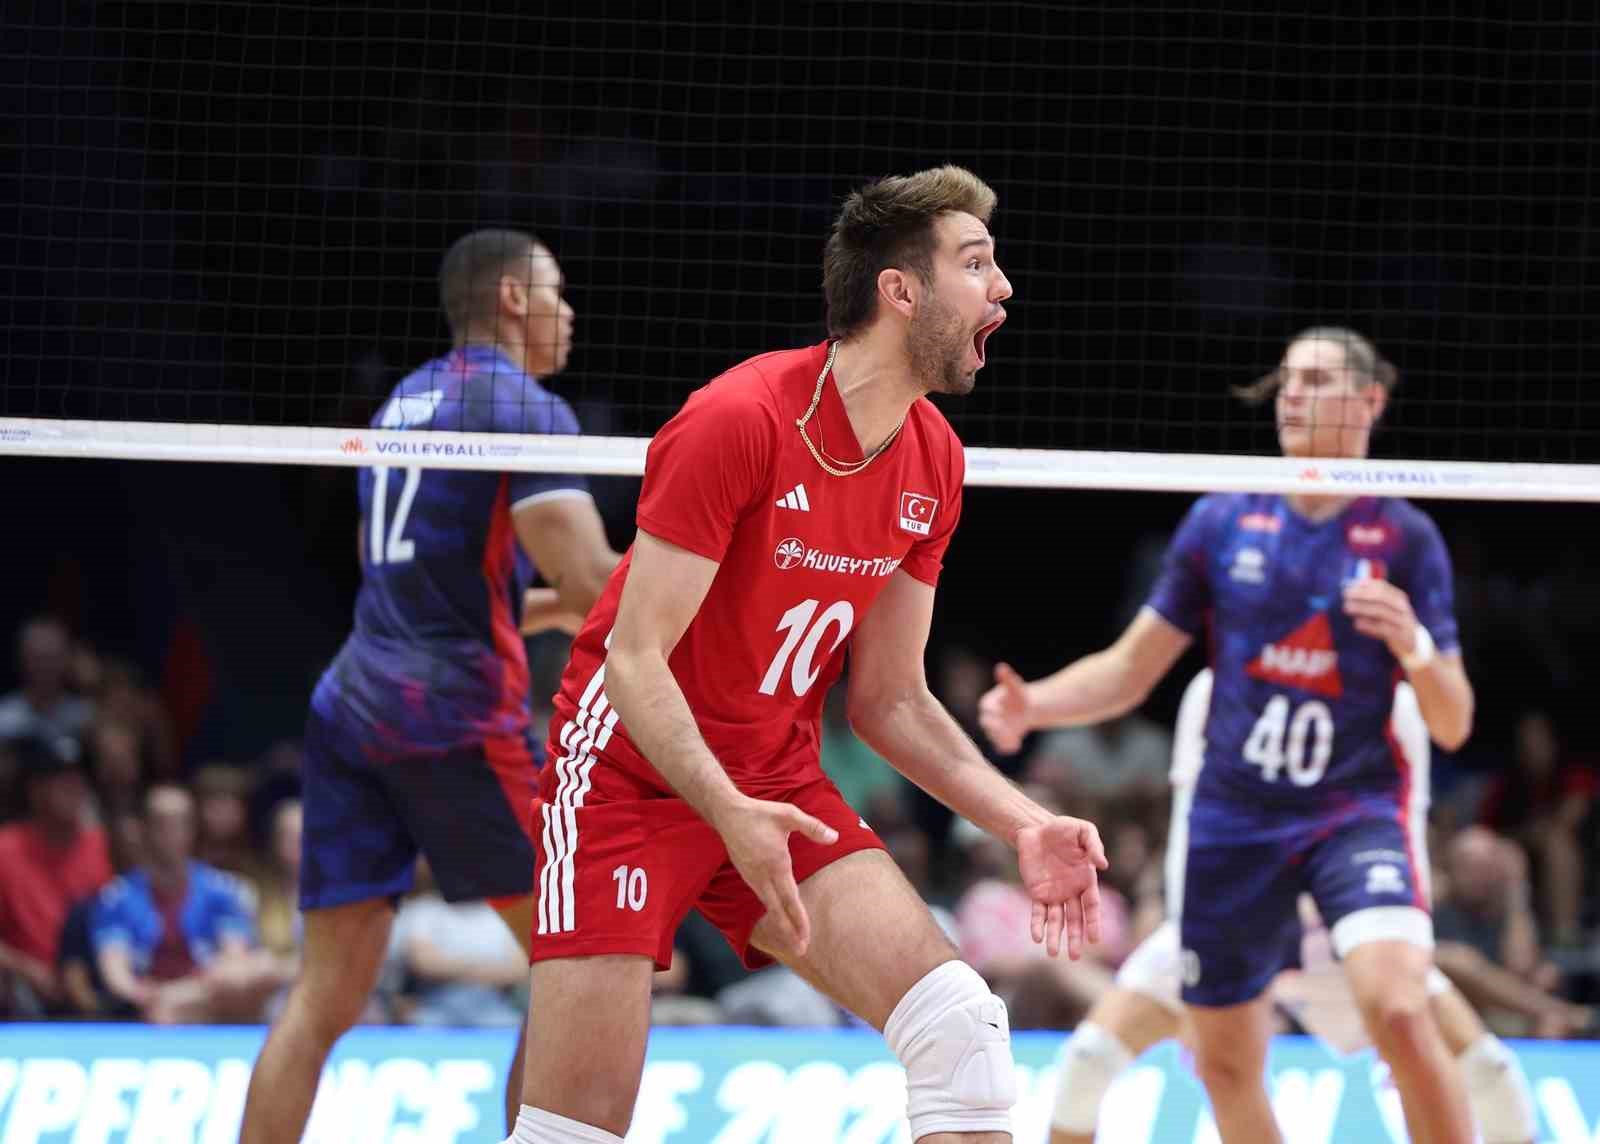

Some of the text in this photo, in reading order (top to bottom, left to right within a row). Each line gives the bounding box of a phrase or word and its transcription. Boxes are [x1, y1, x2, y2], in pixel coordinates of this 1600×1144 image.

[376, 440, 486, 456] VOLLEYBALL
[906, 521, 921, 531] TUR
[758, 599, 854, 697] 10
[1242, 694, 1334, 786] 40
[612, 865, 648, 911] 10
